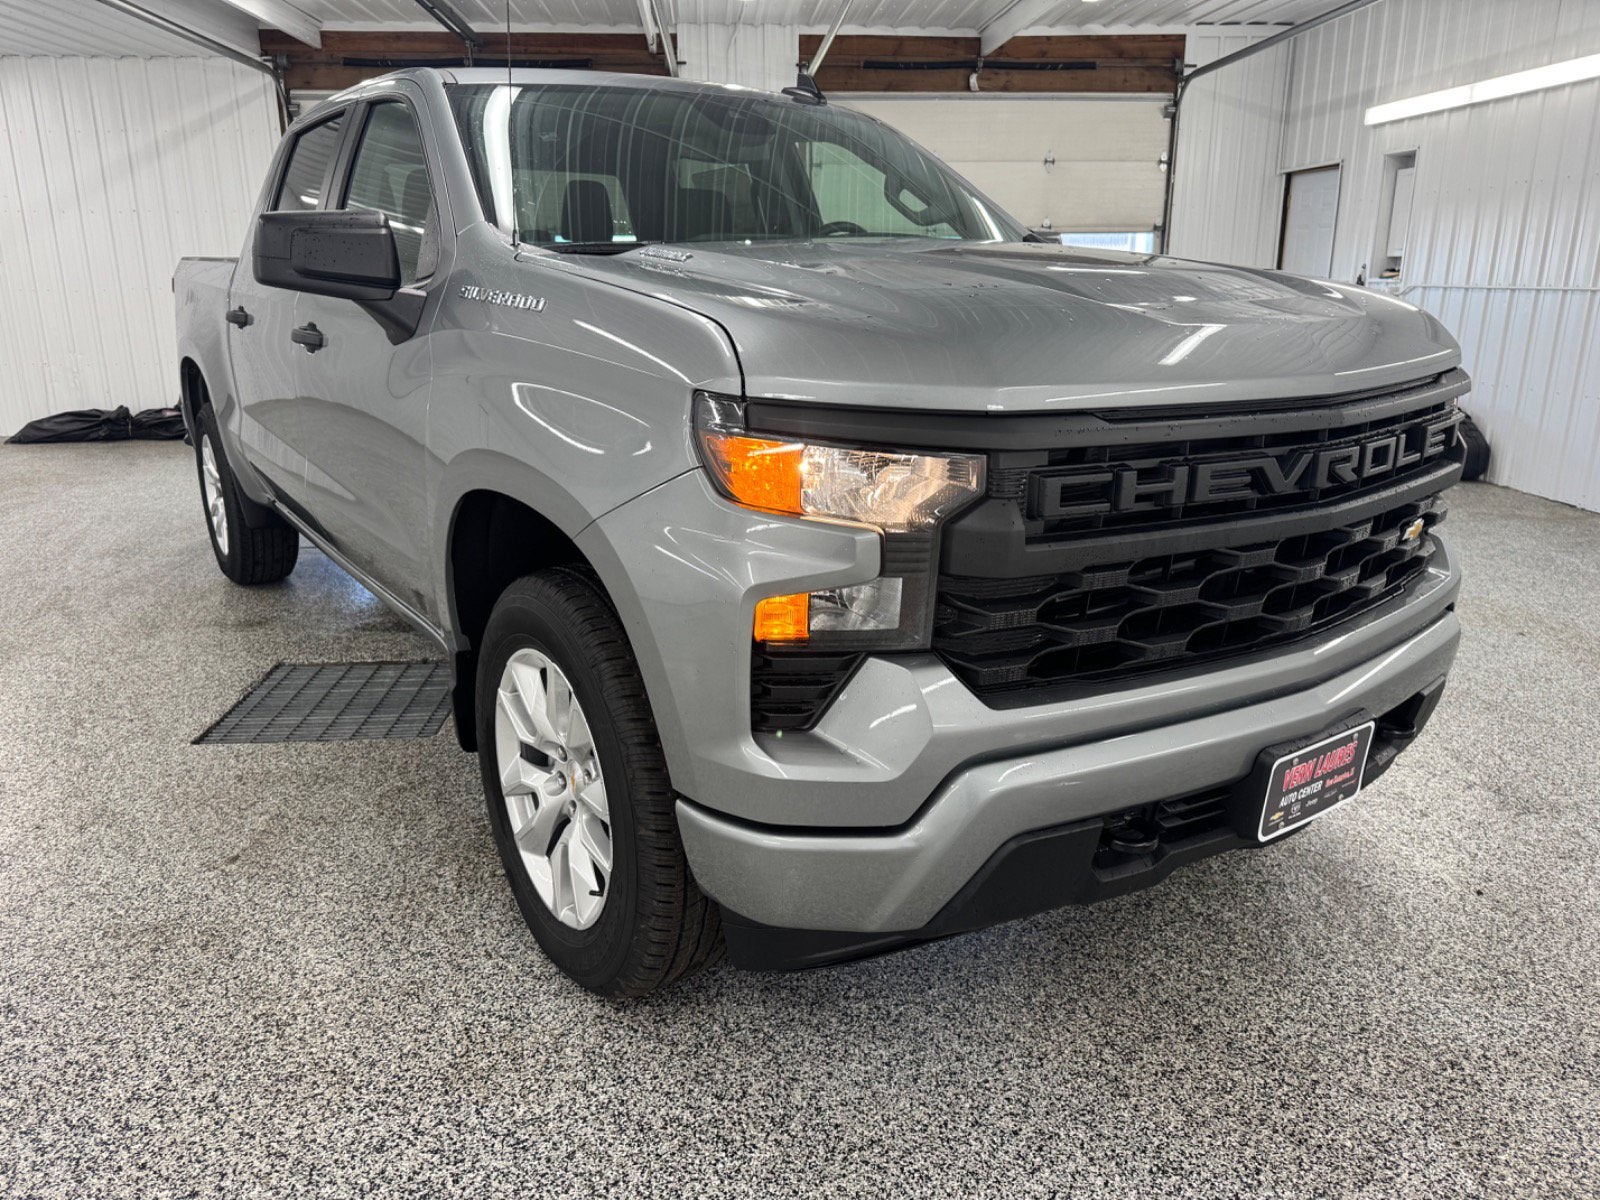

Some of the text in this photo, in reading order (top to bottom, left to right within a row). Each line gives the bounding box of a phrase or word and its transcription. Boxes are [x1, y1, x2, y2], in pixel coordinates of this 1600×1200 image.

[459, 284, 547, 313] SILVERADO
[1038, 411, 1465, 517] CHEVROLET
[1283, 757, 1317, 792] VERN
[1279, 791, 1297, 808] AUTO
[1298, 780, 1323, 800] CENTER
